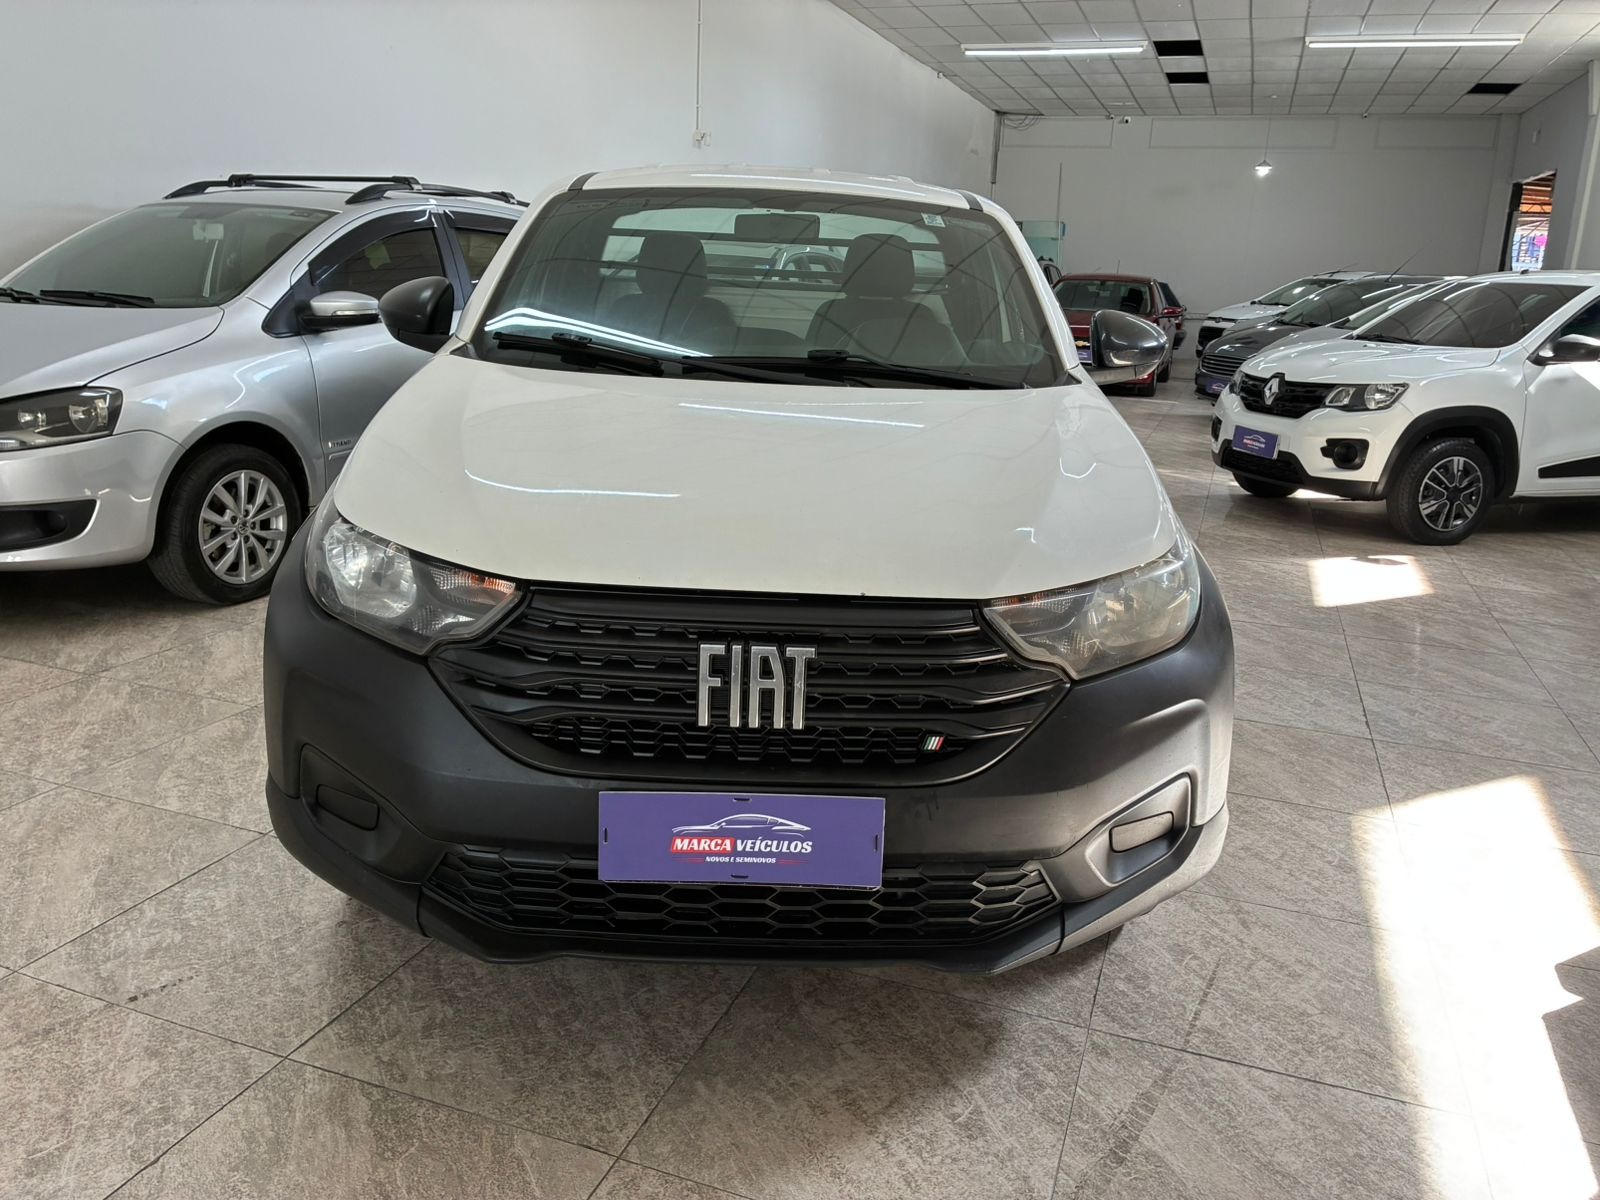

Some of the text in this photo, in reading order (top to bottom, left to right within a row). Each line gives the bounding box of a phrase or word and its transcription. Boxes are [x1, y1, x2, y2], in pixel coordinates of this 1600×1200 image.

[698, 644, 816, 729] FIAT
[672, 837, 812, 853] MARCA VEÍCULOS
[735, 856, 777, 864] SEMINOVOS
